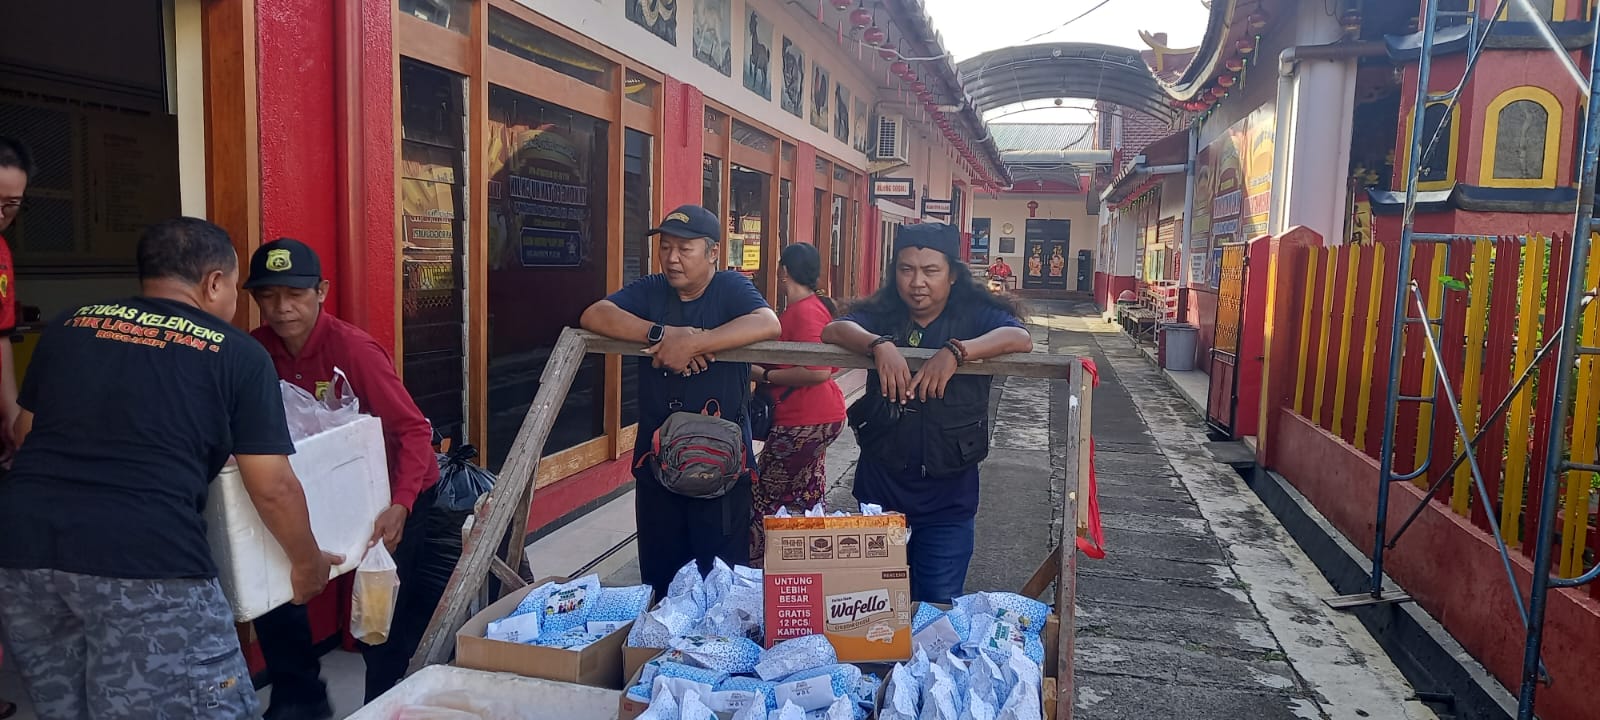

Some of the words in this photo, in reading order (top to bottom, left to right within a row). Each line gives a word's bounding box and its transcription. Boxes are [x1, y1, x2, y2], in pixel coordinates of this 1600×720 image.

[73, 304, 138, 319] PETUGAS
[136, 312, 225, 343] KELENTENG
[101, 318, 159, 338] LIONG
[164, 330, 207, 350] TIAN
[774, 576, 813, 586] UNTUNG
[780, 586, 807, 594] LEBIH
[779, 595, 809, 603] BESAR
[831, 595, 886, 622] Wafello
[778, 609, 811, 618] GRATIS
[779, 618, 790, 627] 12
[777, 627, 813, 636] KARTON
